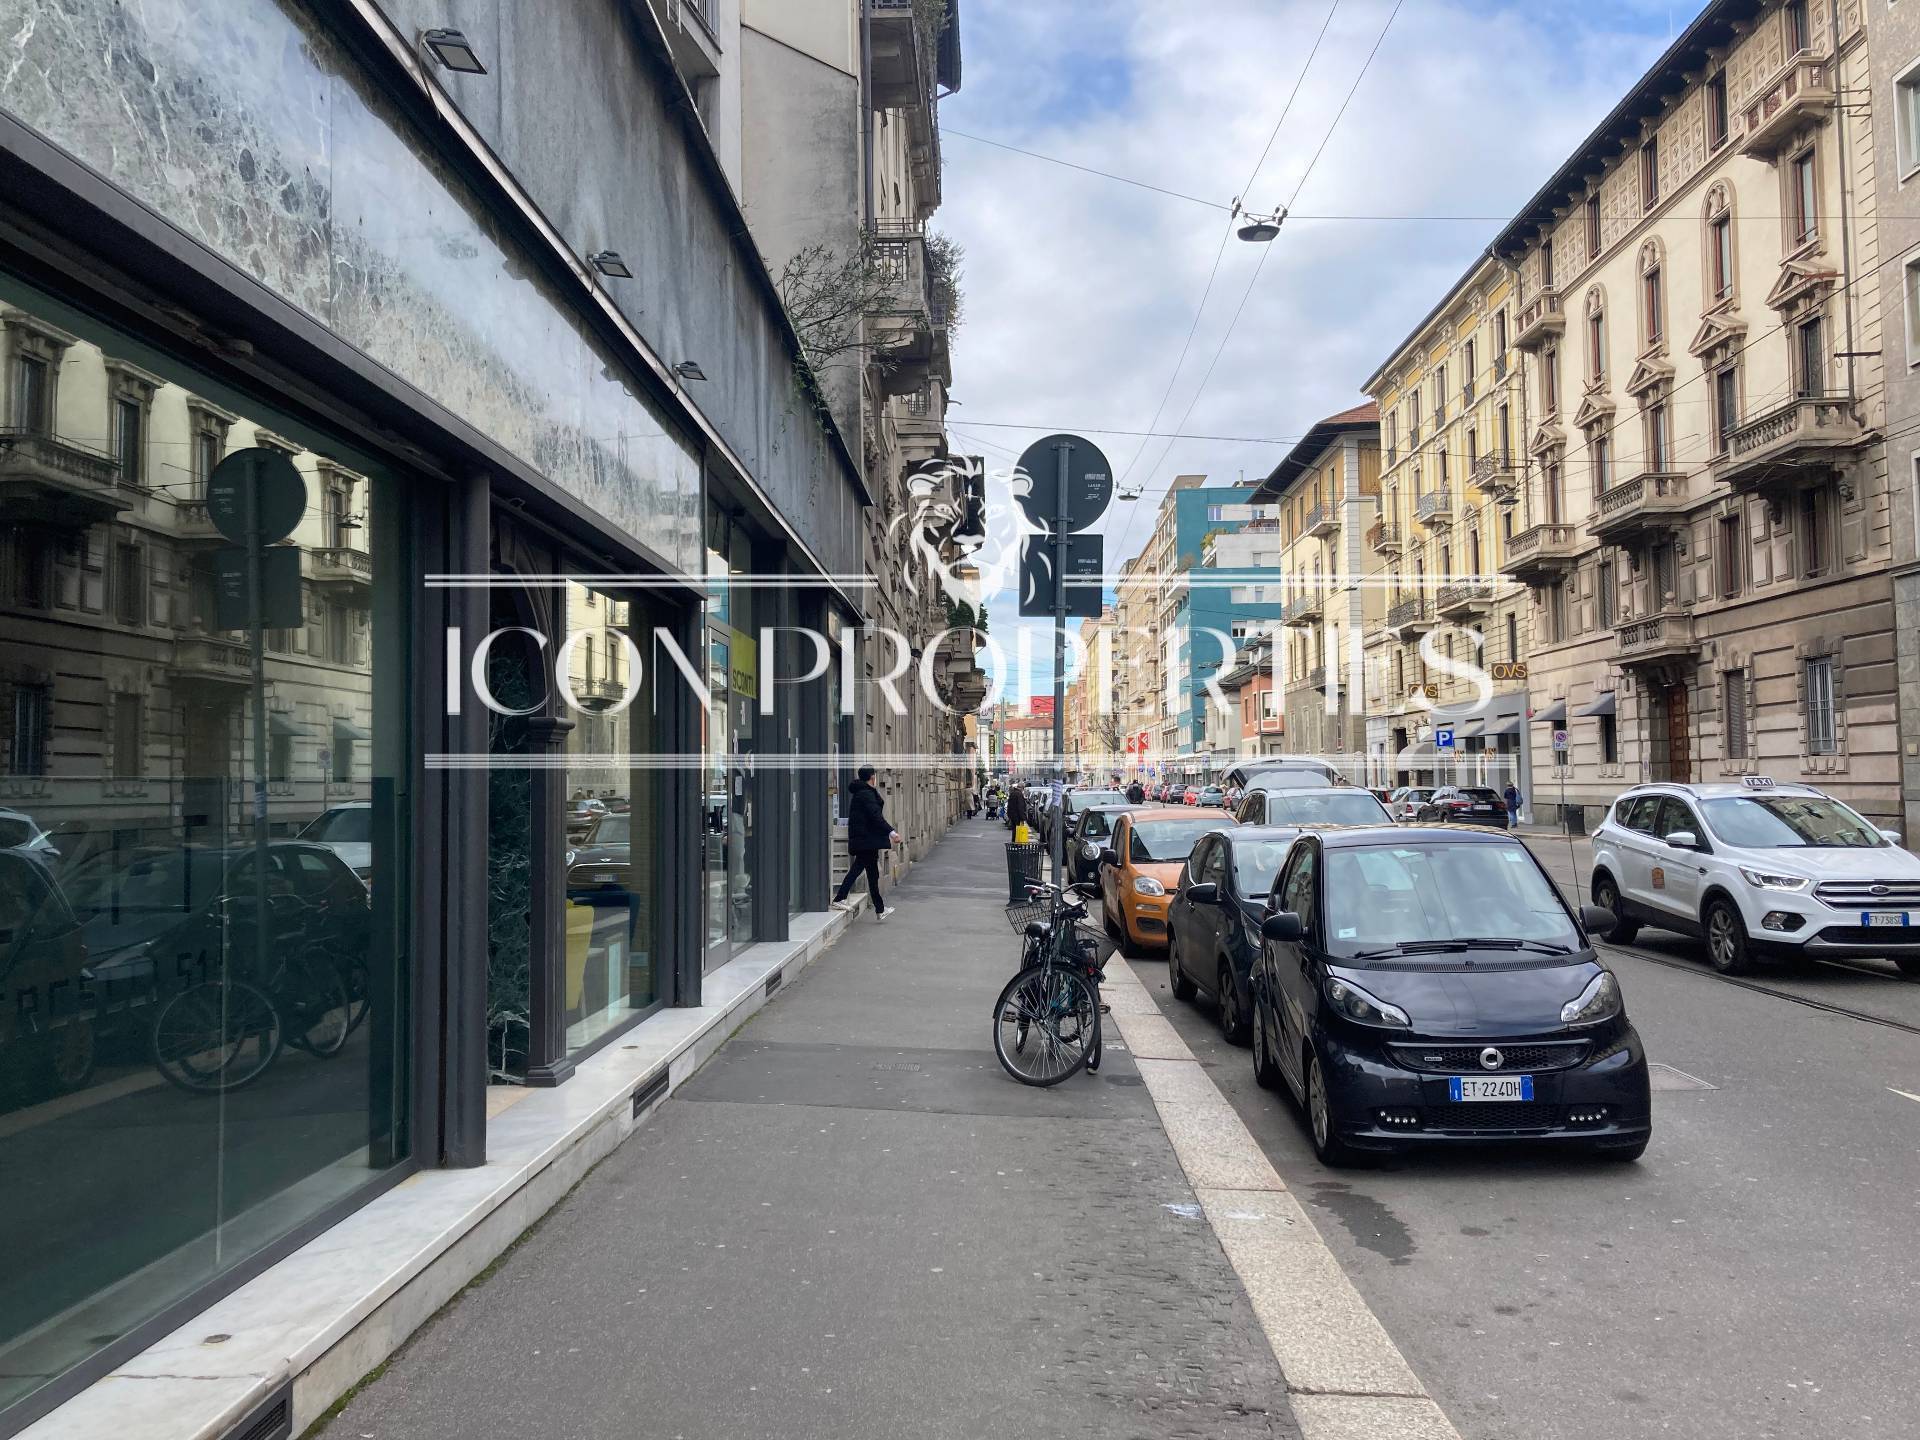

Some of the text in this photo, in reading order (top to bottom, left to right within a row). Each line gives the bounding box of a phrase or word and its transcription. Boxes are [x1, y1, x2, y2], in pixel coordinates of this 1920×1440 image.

[1494, 664, 1526, 678] OVS
[732, 669, 755, 696] SCONTI
[1410, 684, 1437, 698] OVS
[1439, 732, 1450, 745] P
[1746, 778, 1773, 787] TAXI
[1463, 1082, 1521, 1096] ET 224DH
